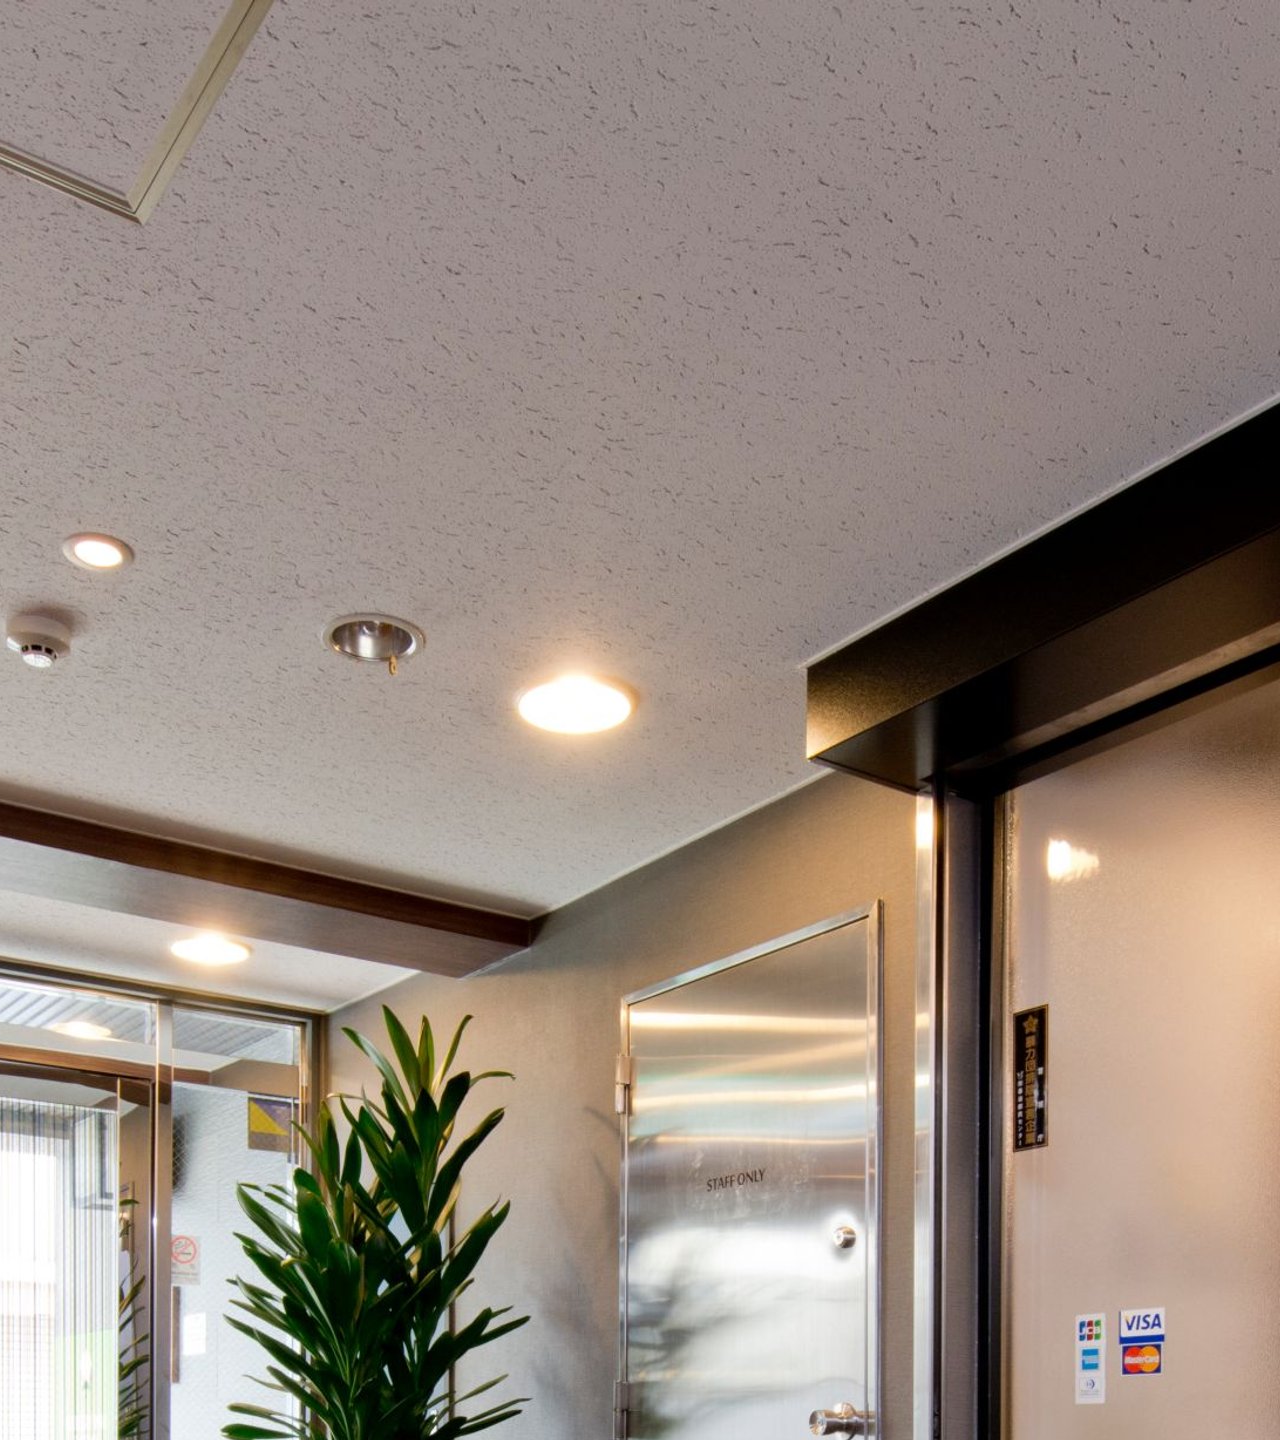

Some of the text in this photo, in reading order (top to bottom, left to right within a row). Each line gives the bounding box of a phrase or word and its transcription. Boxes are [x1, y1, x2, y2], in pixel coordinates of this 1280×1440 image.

[706, 1169, 766, 1192] STAFF ONLY
[1125, 1313, 1162, 1331] VISA
